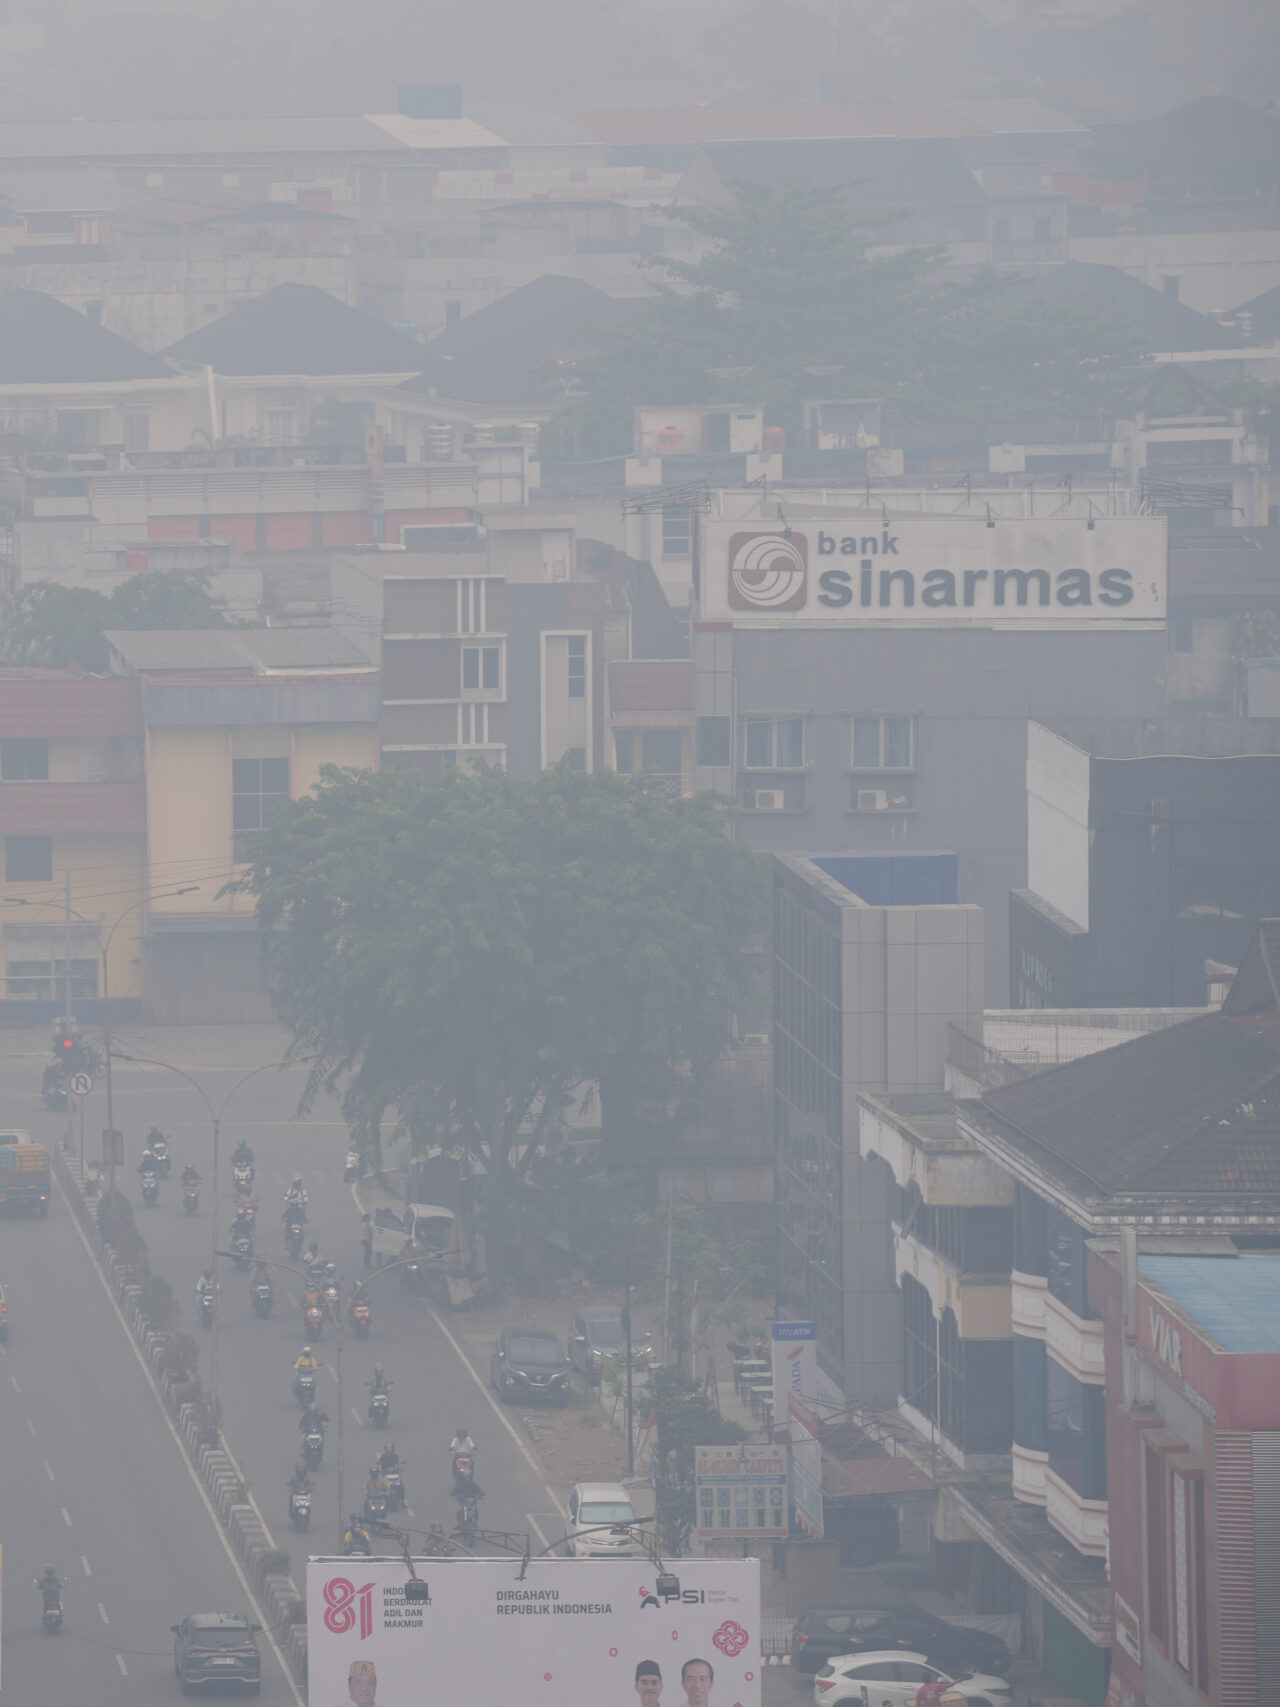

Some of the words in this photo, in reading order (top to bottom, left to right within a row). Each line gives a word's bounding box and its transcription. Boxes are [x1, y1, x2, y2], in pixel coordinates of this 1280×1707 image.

[819, 531, 899, 556] bank
[820, 560, 1134, 608] sinarmas
[496, 1590, 559, 1601] DIRGAHAYU
[323, 1577, 377, 1641] 81
[384, 1608, 403, 1617] ADIL
[405, 1608, 423, 1617] DAN
[496, 1604, 550, 1615] REPUBLIK
[552, 1604, 613, 1615] INDONESIA
[384, 1619, 424, 1628] MAKMUR
